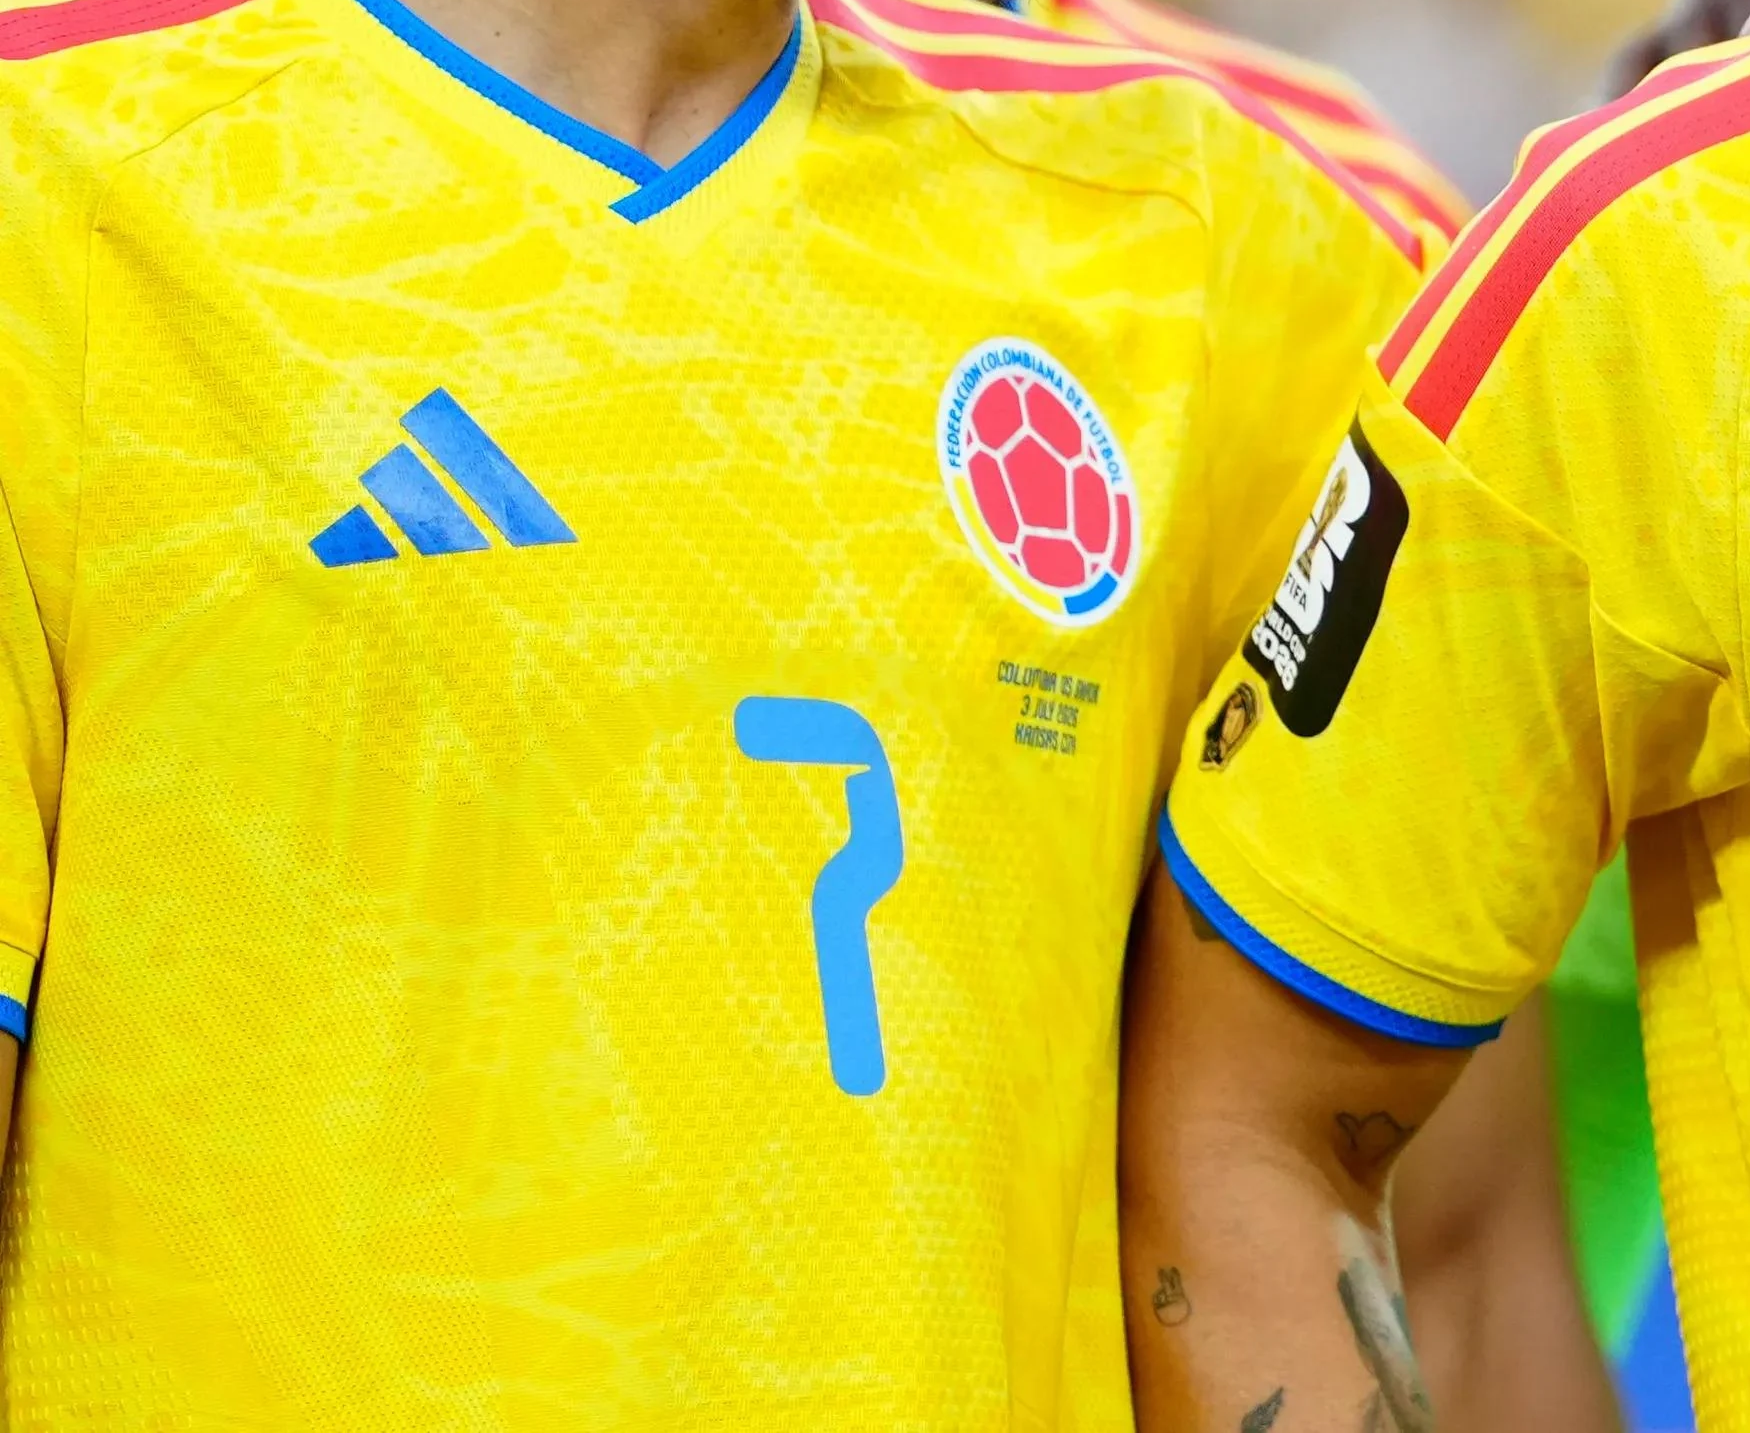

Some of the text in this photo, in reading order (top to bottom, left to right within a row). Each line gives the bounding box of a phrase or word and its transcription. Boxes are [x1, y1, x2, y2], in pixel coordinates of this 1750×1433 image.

[981, 348, 1063, 391] COLOMBIANA
[1066, 386, 1083, 410] DE
[1284, 572, 1307, 612] FIFA
[1020, 694, 1031, 716] 3
[1014, 723, 1059, 752] KANSAS
[733, 695, 905, 1097] 7
